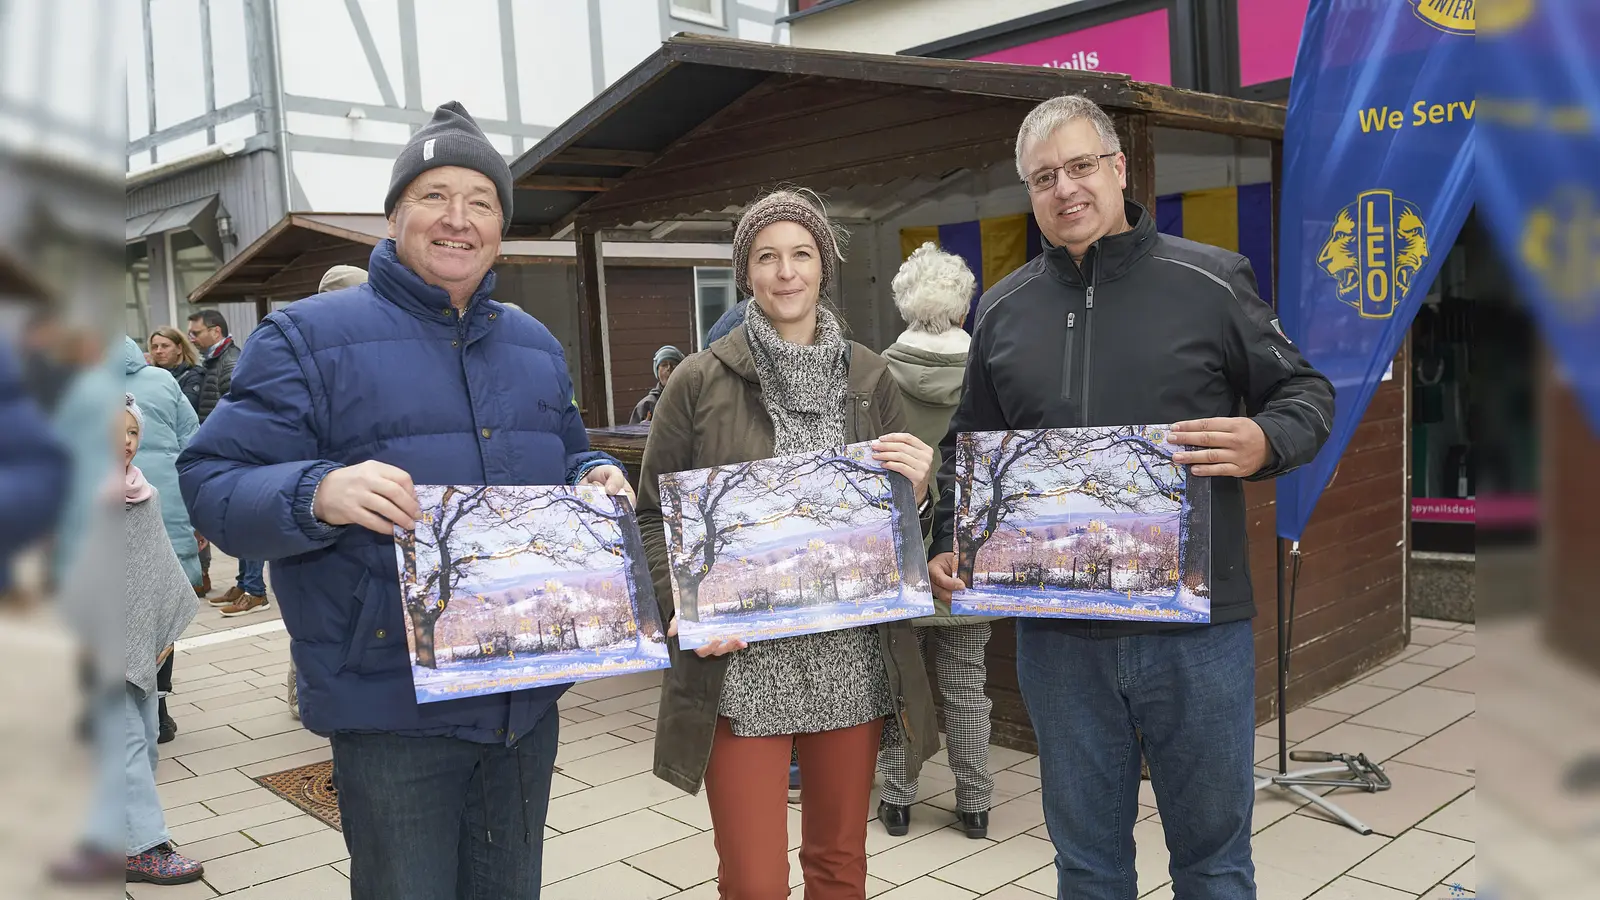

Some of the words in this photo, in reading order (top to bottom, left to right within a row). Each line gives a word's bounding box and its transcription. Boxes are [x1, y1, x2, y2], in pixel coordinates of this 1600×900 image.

[1359, 106, 1404, 133] We
[1367, 201, 1387, 302] LEO
[1056, 495, 1066, 505] 18
[1170, 492, 1181, 502] 15
[983, 530, 989, 541] 9
[1150, 525, 1160, 536] 19
[702, 563, 709, 575] 9
[1127, 559, 1137, 570] 21
[1169, 570, 1179, 581] 16
[1039, 581, 1044, 591] 3
[438, 599, 445, 611] 9
[508, 651, 515, 662] 3
